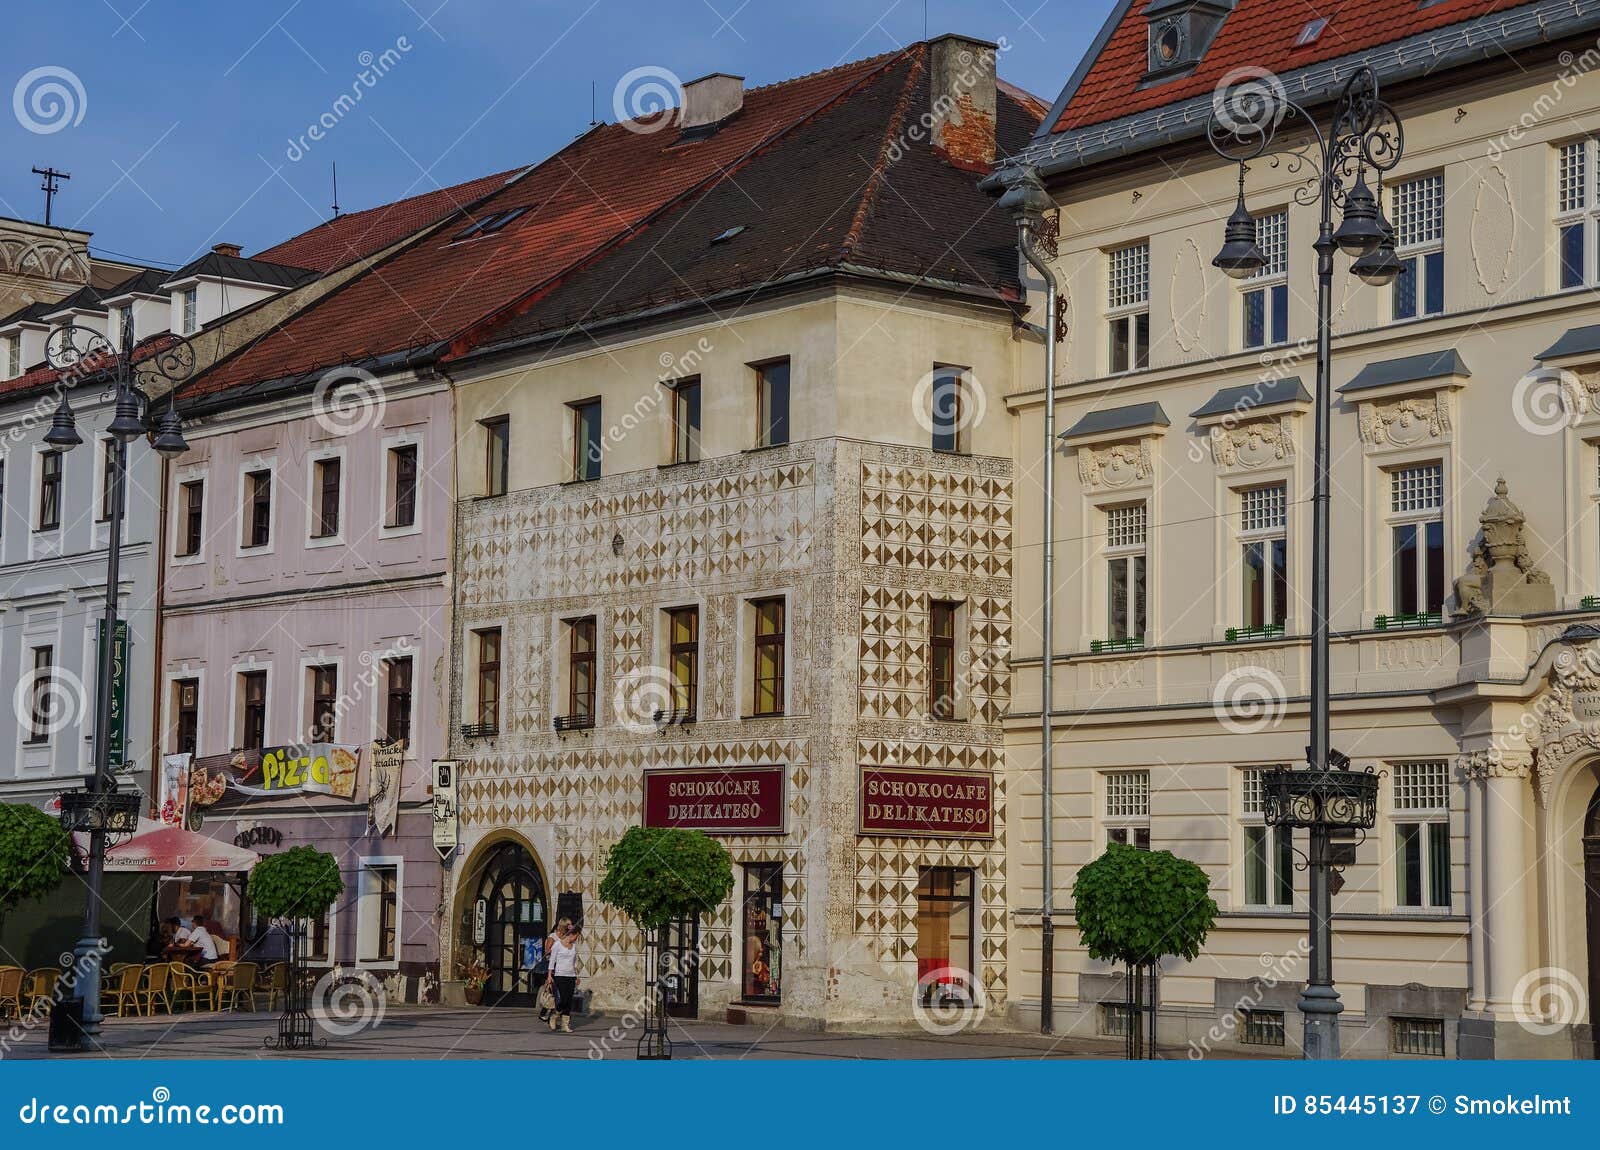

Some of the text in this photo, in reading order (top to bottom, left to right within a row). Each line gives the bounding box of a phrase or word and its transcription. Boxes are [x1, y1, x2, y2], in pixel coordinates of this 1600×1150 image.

[669, 780, 761, 797] SCHOKOCAFE
[868, 781, 987, 801] SCHOKOCAFE
[667, 802, 761, 820] DELIKATESO
[868, 803, 988, 824] DELIKATESO
